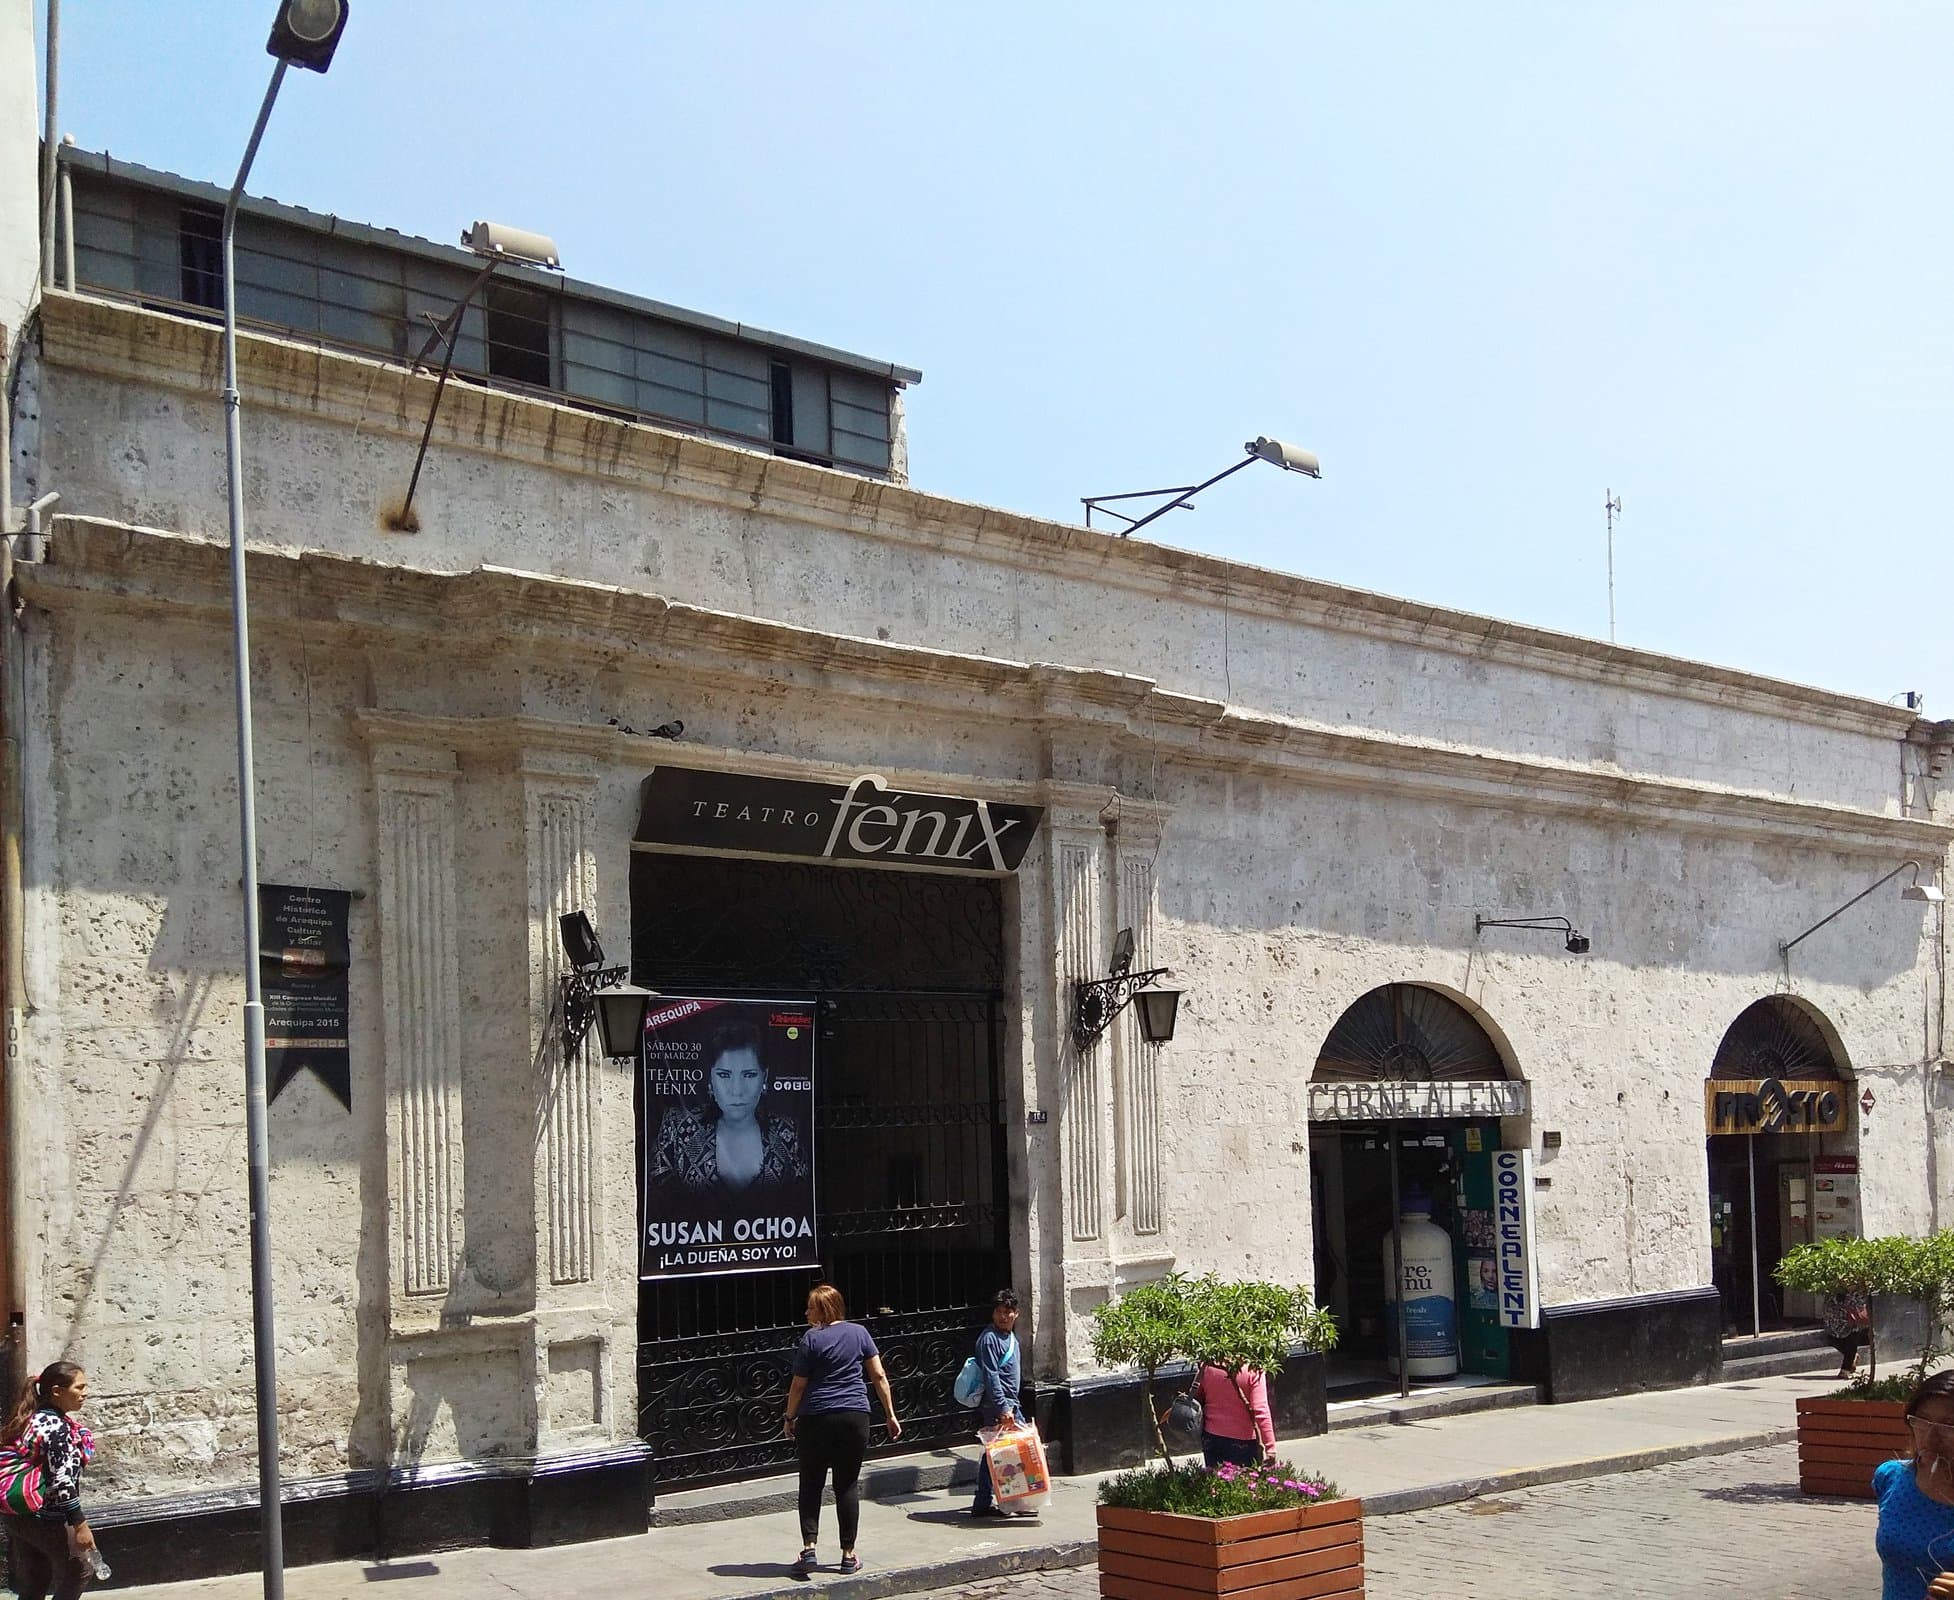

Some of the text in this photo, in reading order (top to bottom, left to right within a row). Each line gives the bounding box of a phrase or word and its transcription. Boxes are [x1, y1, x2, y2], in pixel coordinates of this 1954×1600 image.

[693, 800, 821, 827] TEATRO
[289, 894, 322, 904] Centro
[290, 916, 333, 927] Arequipa
[287, 926, 322, 936] Cultura
[645, 1001, 702, 1029] AREQUIPA
[268, 1018, 340, 1028] Arequipa 2015
[647, 1040, 702, 1052] SÁBADO 30
[650, 1051, 699, 1060] DE MARZO
[647, 1068, 703, 1081] TEATRO
[648, 1216, 813, 1246] SUSAN OCHOA
[1497, 1152, 1526, 1326] CORNEALENT
[660, 1245, 797, 1269] ¡LA DUEÑA SOY YO!
[1404, 1278, 1433, 1291] nu
[1406, 1306, 1427, 1314] fresh
